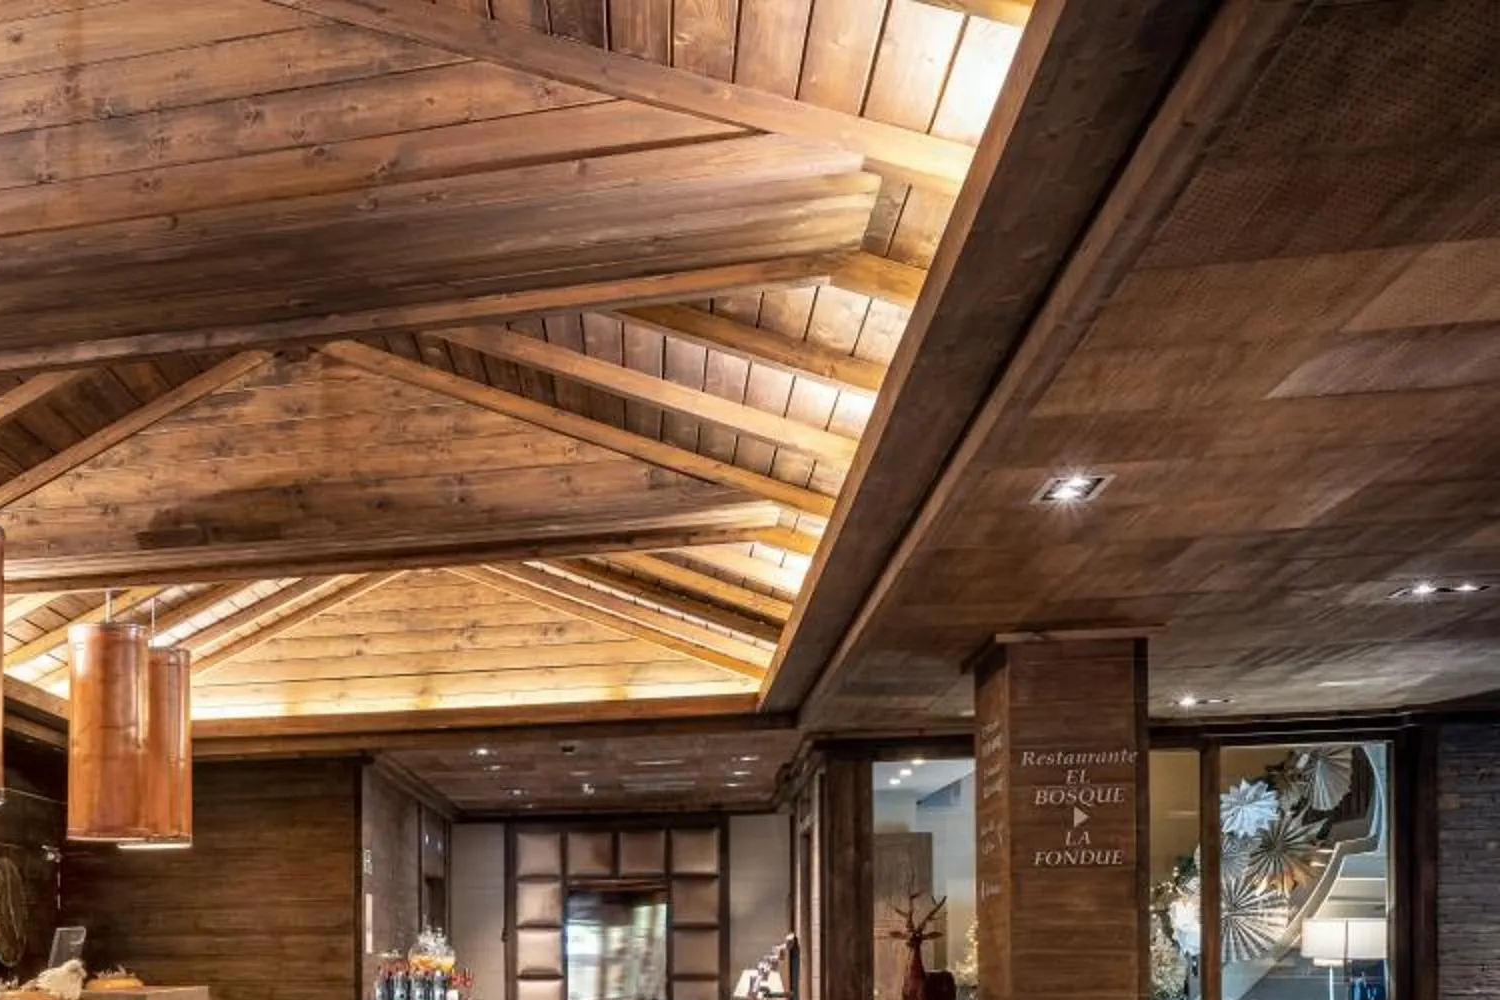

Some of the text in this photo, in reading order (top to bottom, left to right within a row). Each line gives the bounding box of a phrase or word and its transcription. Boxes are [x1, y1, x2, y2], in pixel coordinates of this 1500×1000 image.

[1021, 748, 1139, 767] Restaurante
[1065, 769, 1091, 785] EL
[1035, 787, 1125, 807] BOSQUE
[1065, 830, 1092, 847] LA
[1034, 849, 1124, 866] FONDUE
